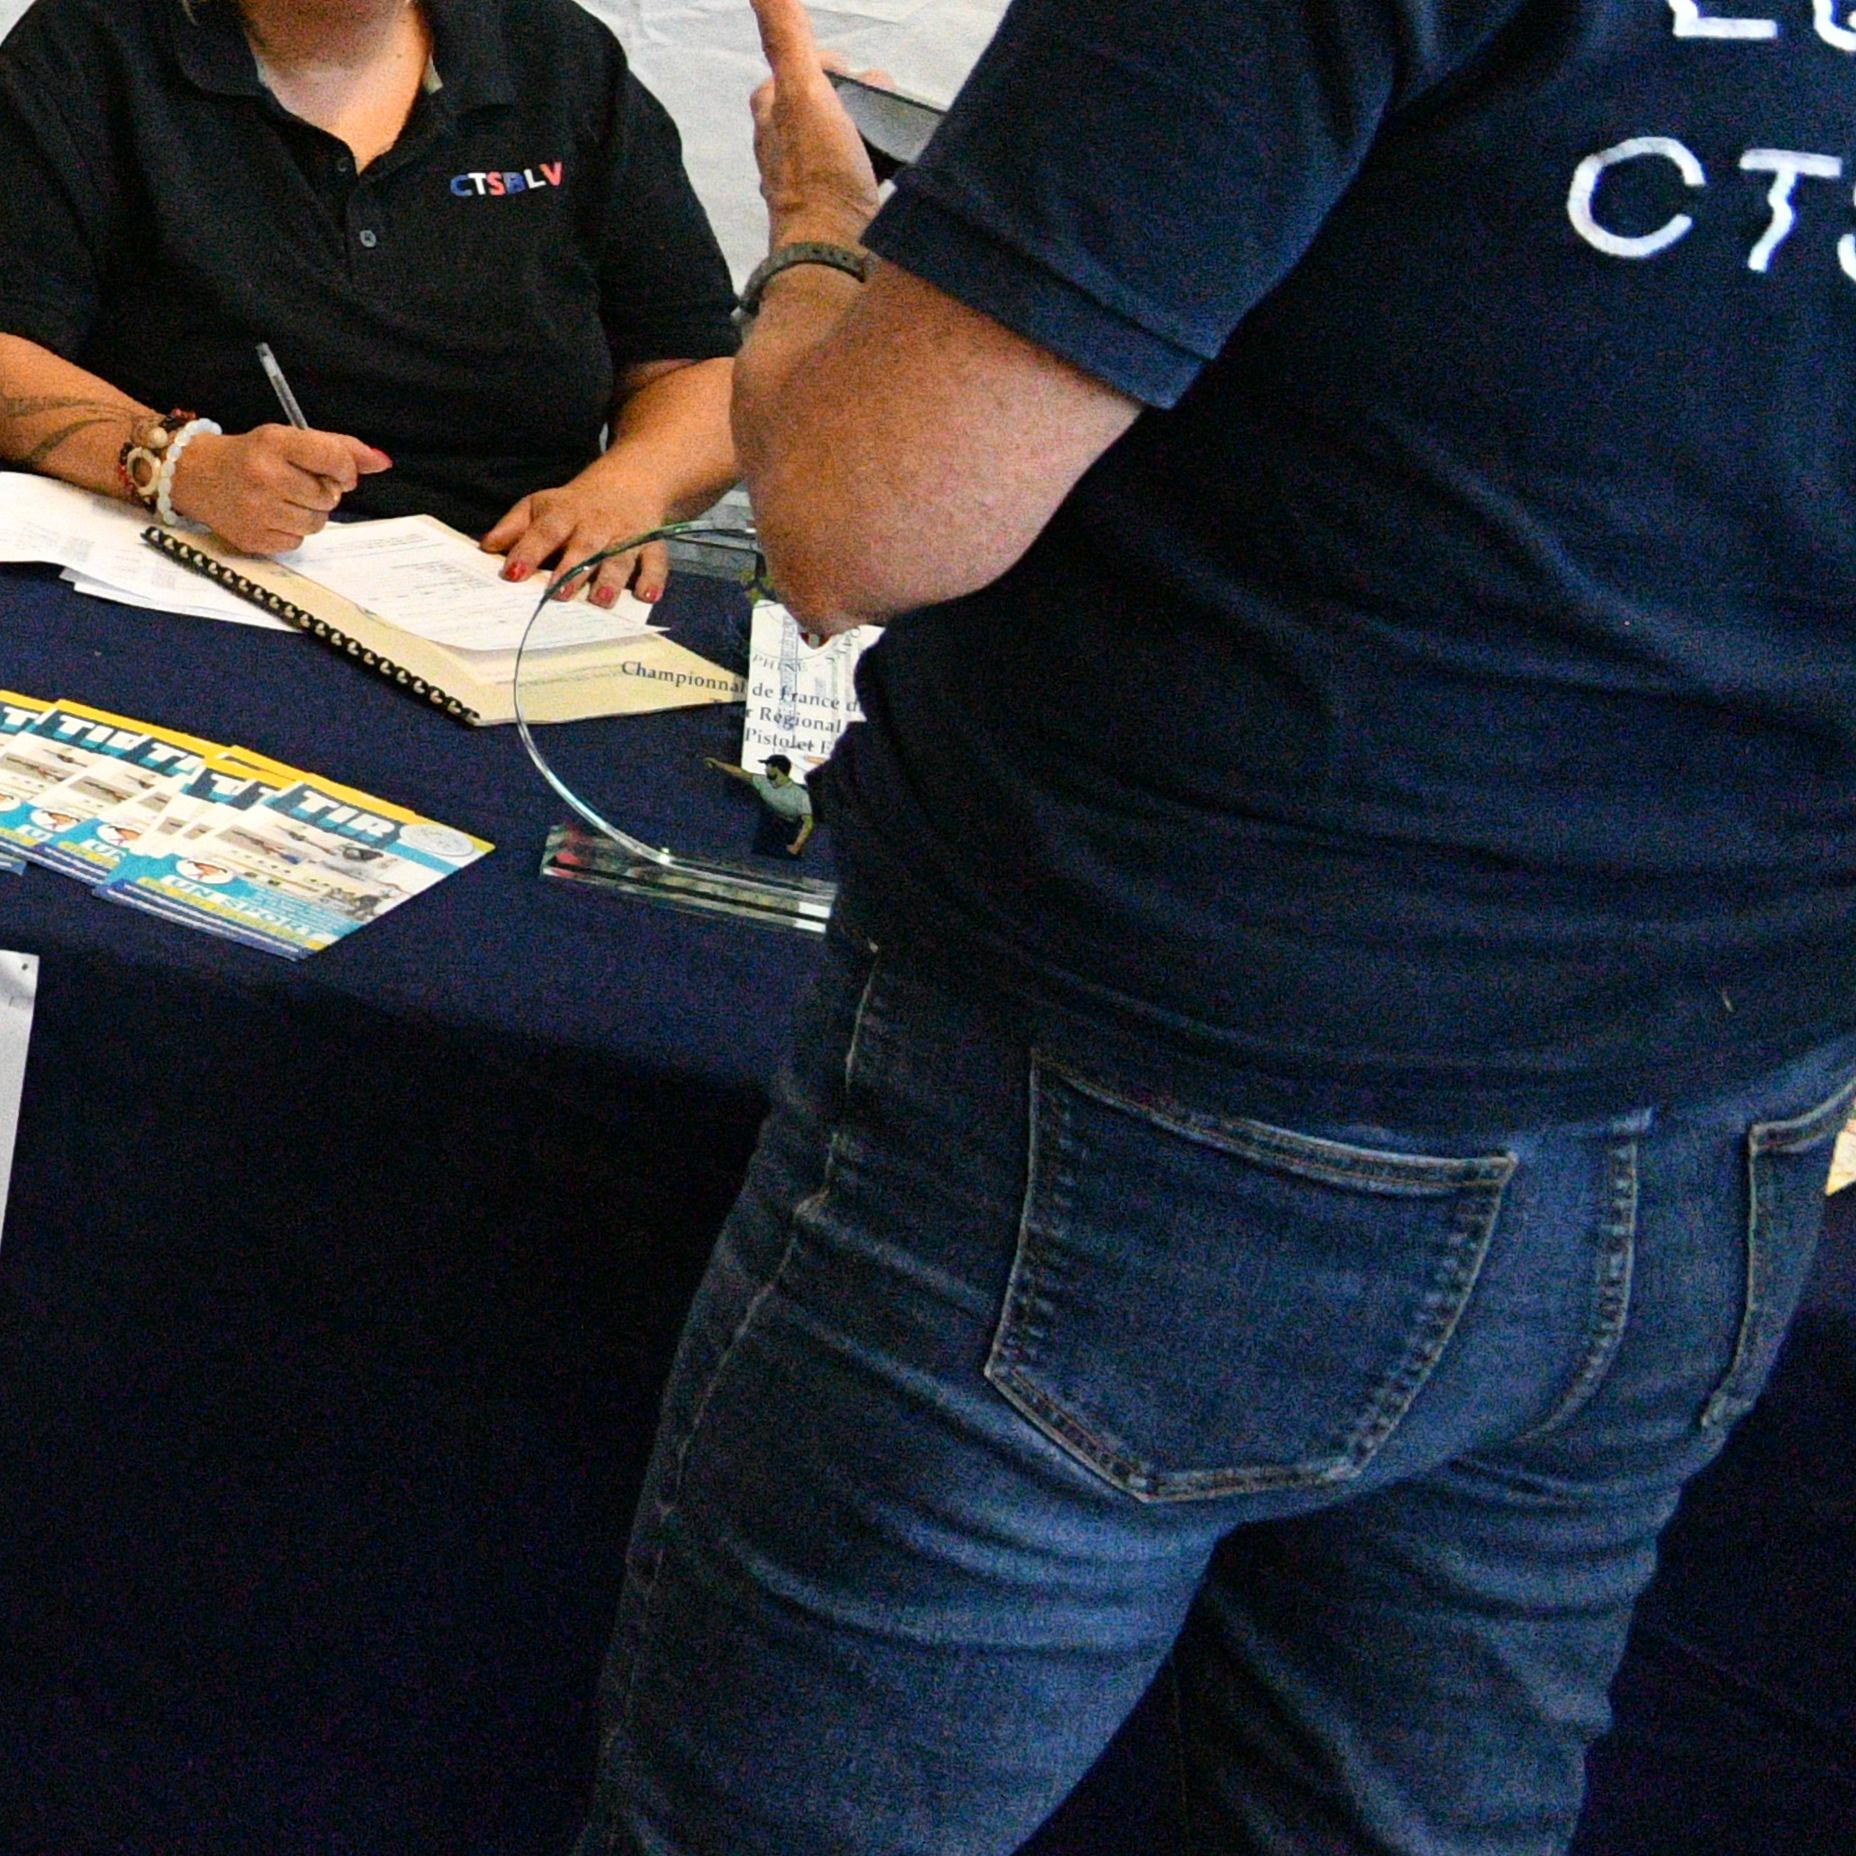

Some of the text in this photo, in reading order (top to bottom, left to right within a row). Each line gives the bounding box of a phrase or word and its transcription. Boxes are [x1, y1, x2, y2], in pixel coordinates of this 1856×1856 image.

[450, 161, 564, 196] CTSBLV
[1567, 136, 1856, 282] CT
[752, 682, 773, 699] de
[780, 685, 840, 710] France
[745, 727, 815, 754] Pistolet
[302, 789, 396, 838] TIR
[161, 875, 329, 938] UN SPORT
